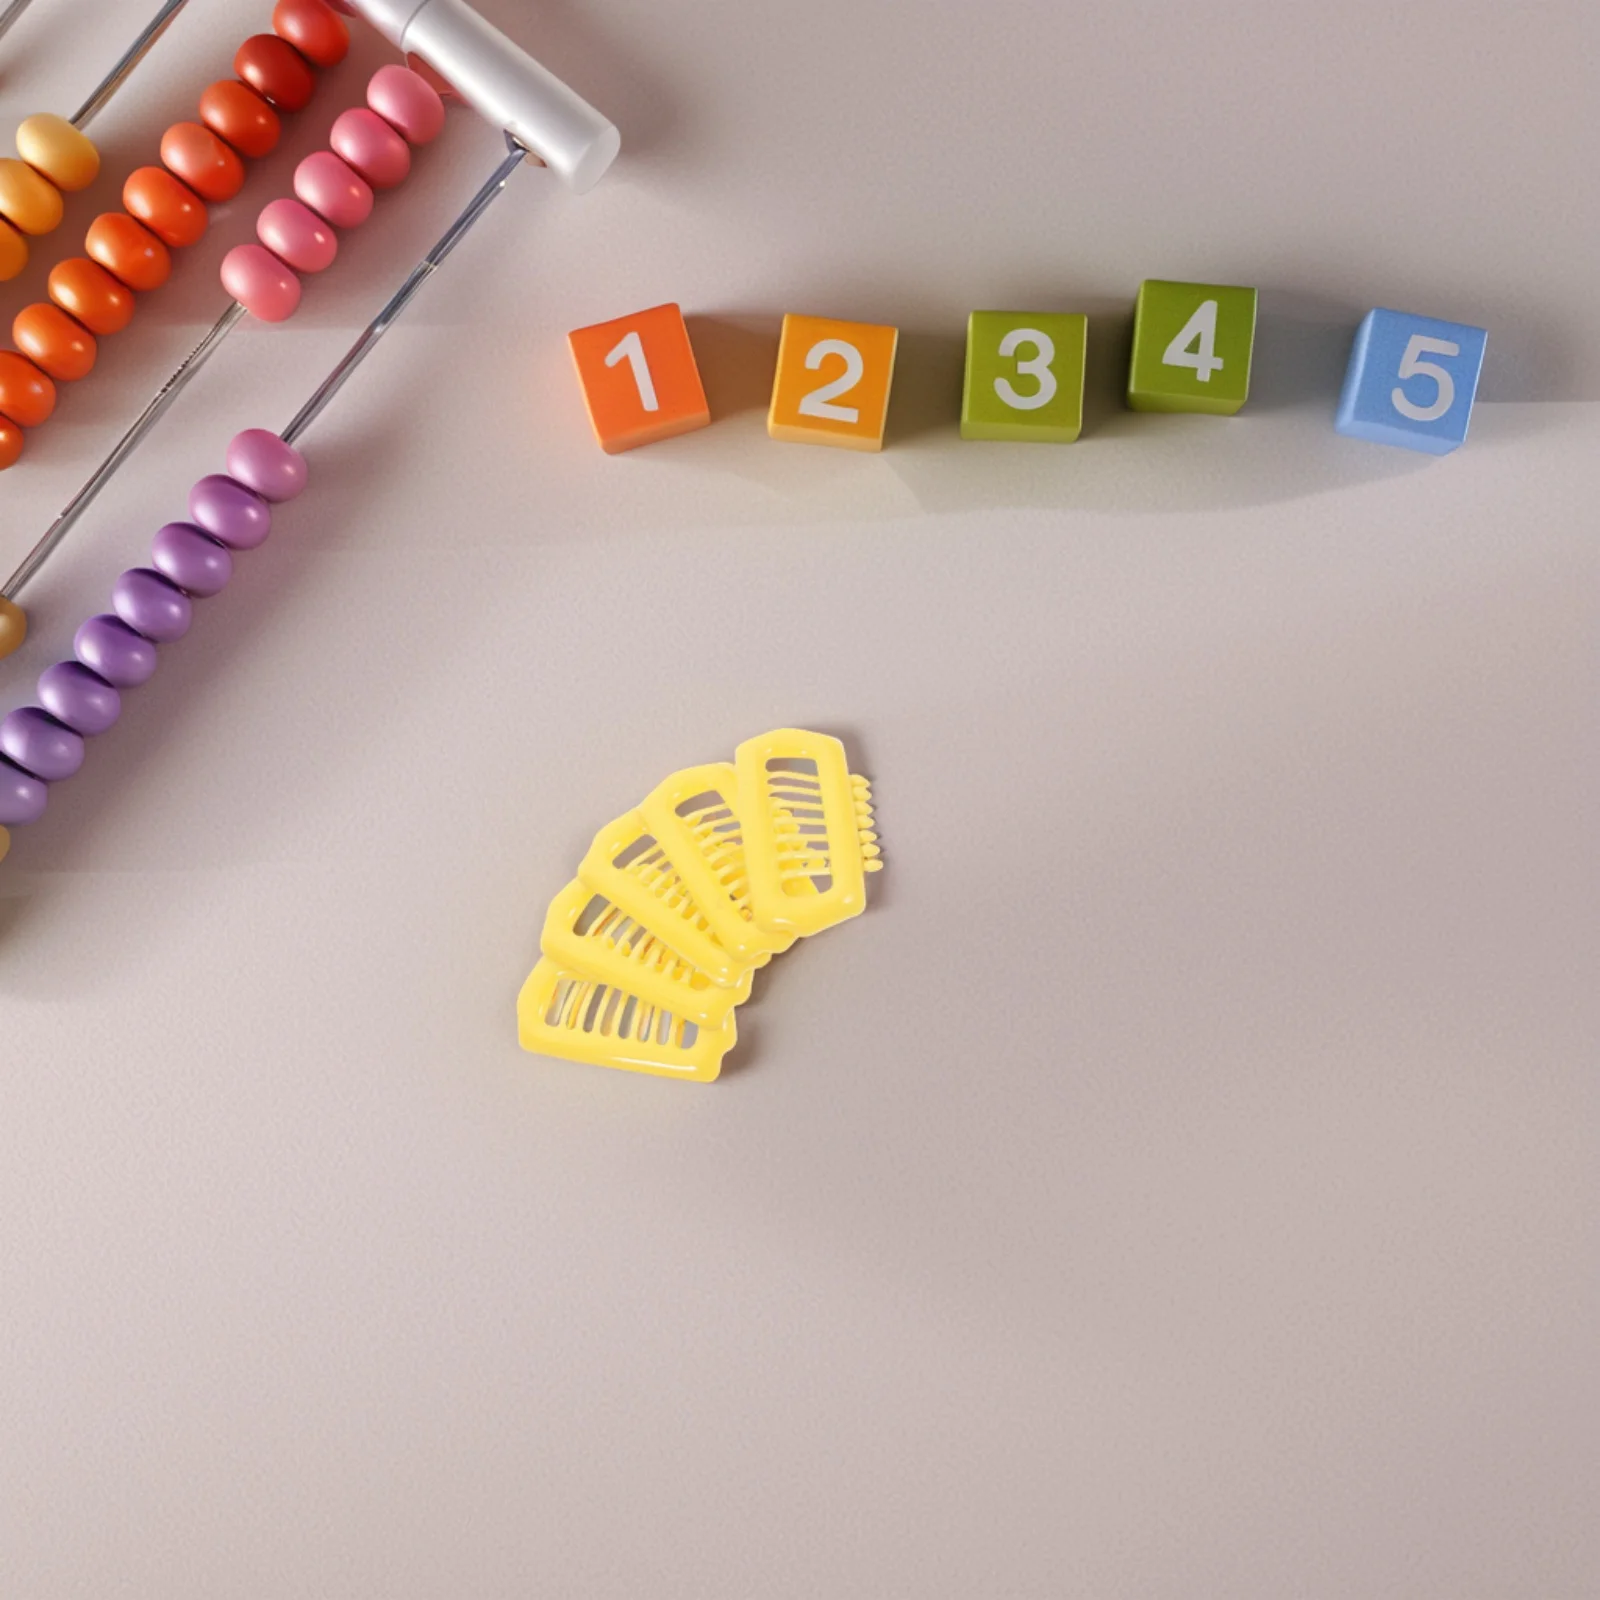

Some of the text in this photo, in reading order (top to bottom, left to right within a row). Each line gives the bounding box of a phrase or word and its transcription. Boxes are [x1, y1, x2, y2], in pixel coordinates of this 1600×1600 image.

[603, 331, 659, 413] 1
[798, 338, 864, 424] 2
[993, 328, 1058, 411] 3
[1161, 299, 1225, 383] 4
[1391, 335, 1461, 422] 5
